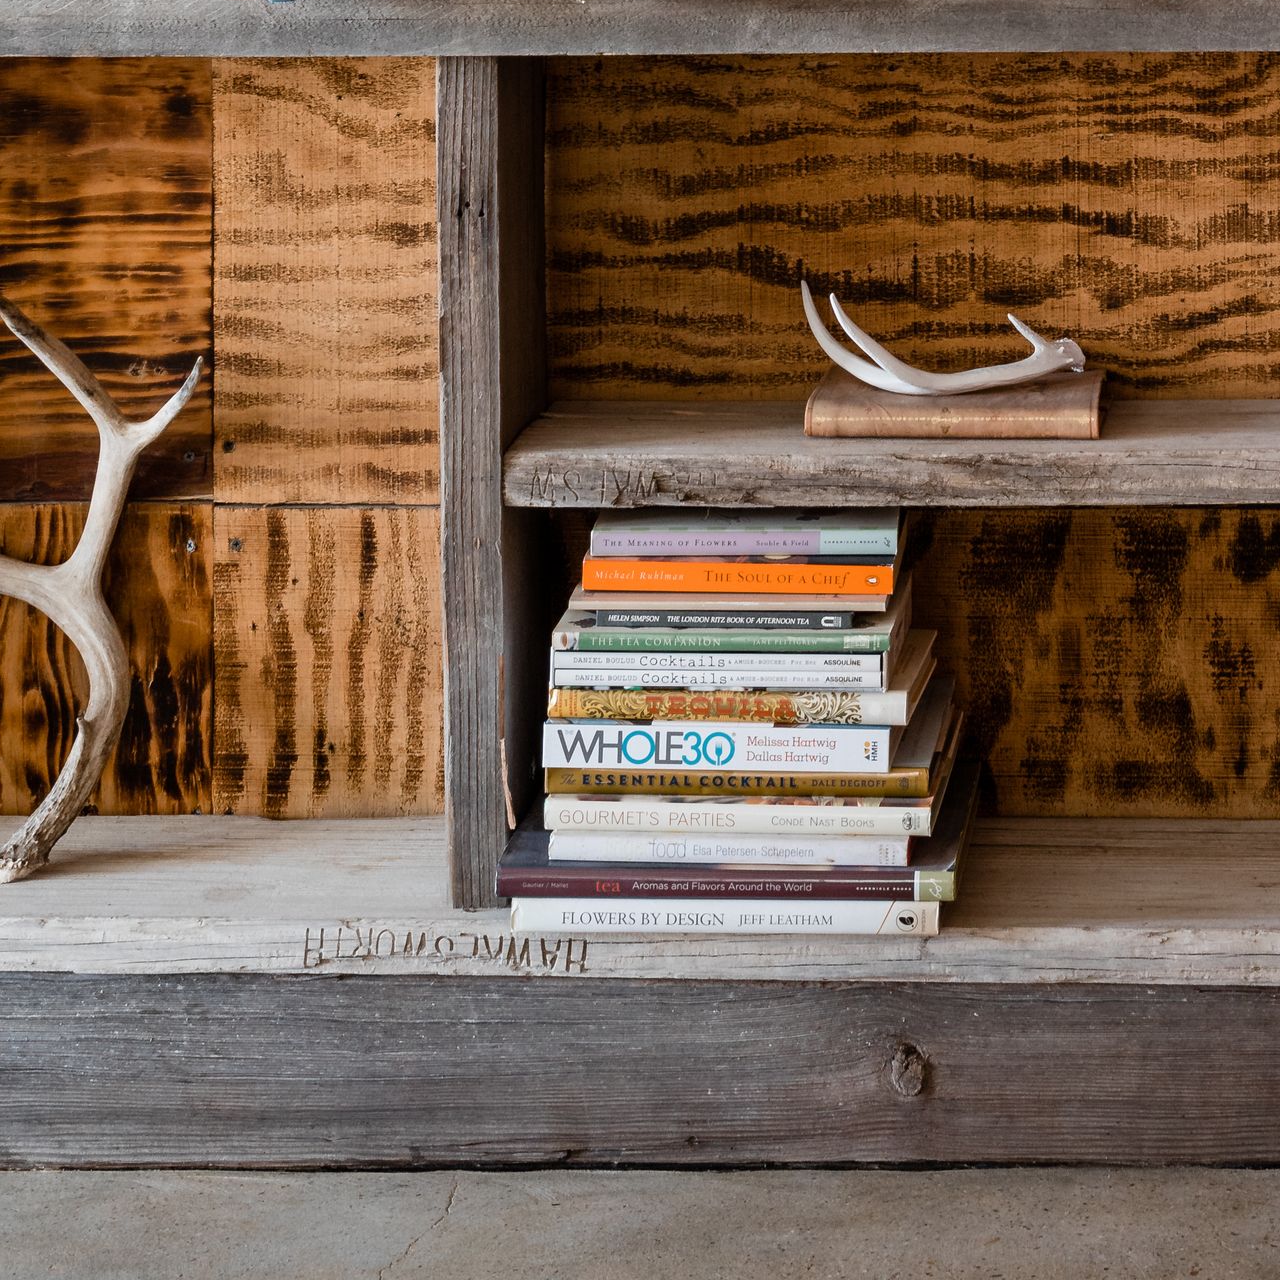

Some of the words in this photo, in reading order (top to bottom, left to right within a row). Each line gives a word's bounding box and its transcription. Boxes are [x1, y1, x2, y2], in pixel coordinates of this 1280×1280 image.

[645, 696, 797, 718] TEQUILA
[747, 736, 790, 747] Melissa
[792, 737, 837, 750] Hartwig
[746, 751, 782, 762] Dallas
[785, 752, 829, 765] Hartwig
[561, 912, 636, 925] FLOWERS
[641, 913, 661, 926] BY
[666, 913, 725, 926] DESIGN
[738, 914, 766, 927] JEFF
[769, 915, 833, 926] LEATHAM
